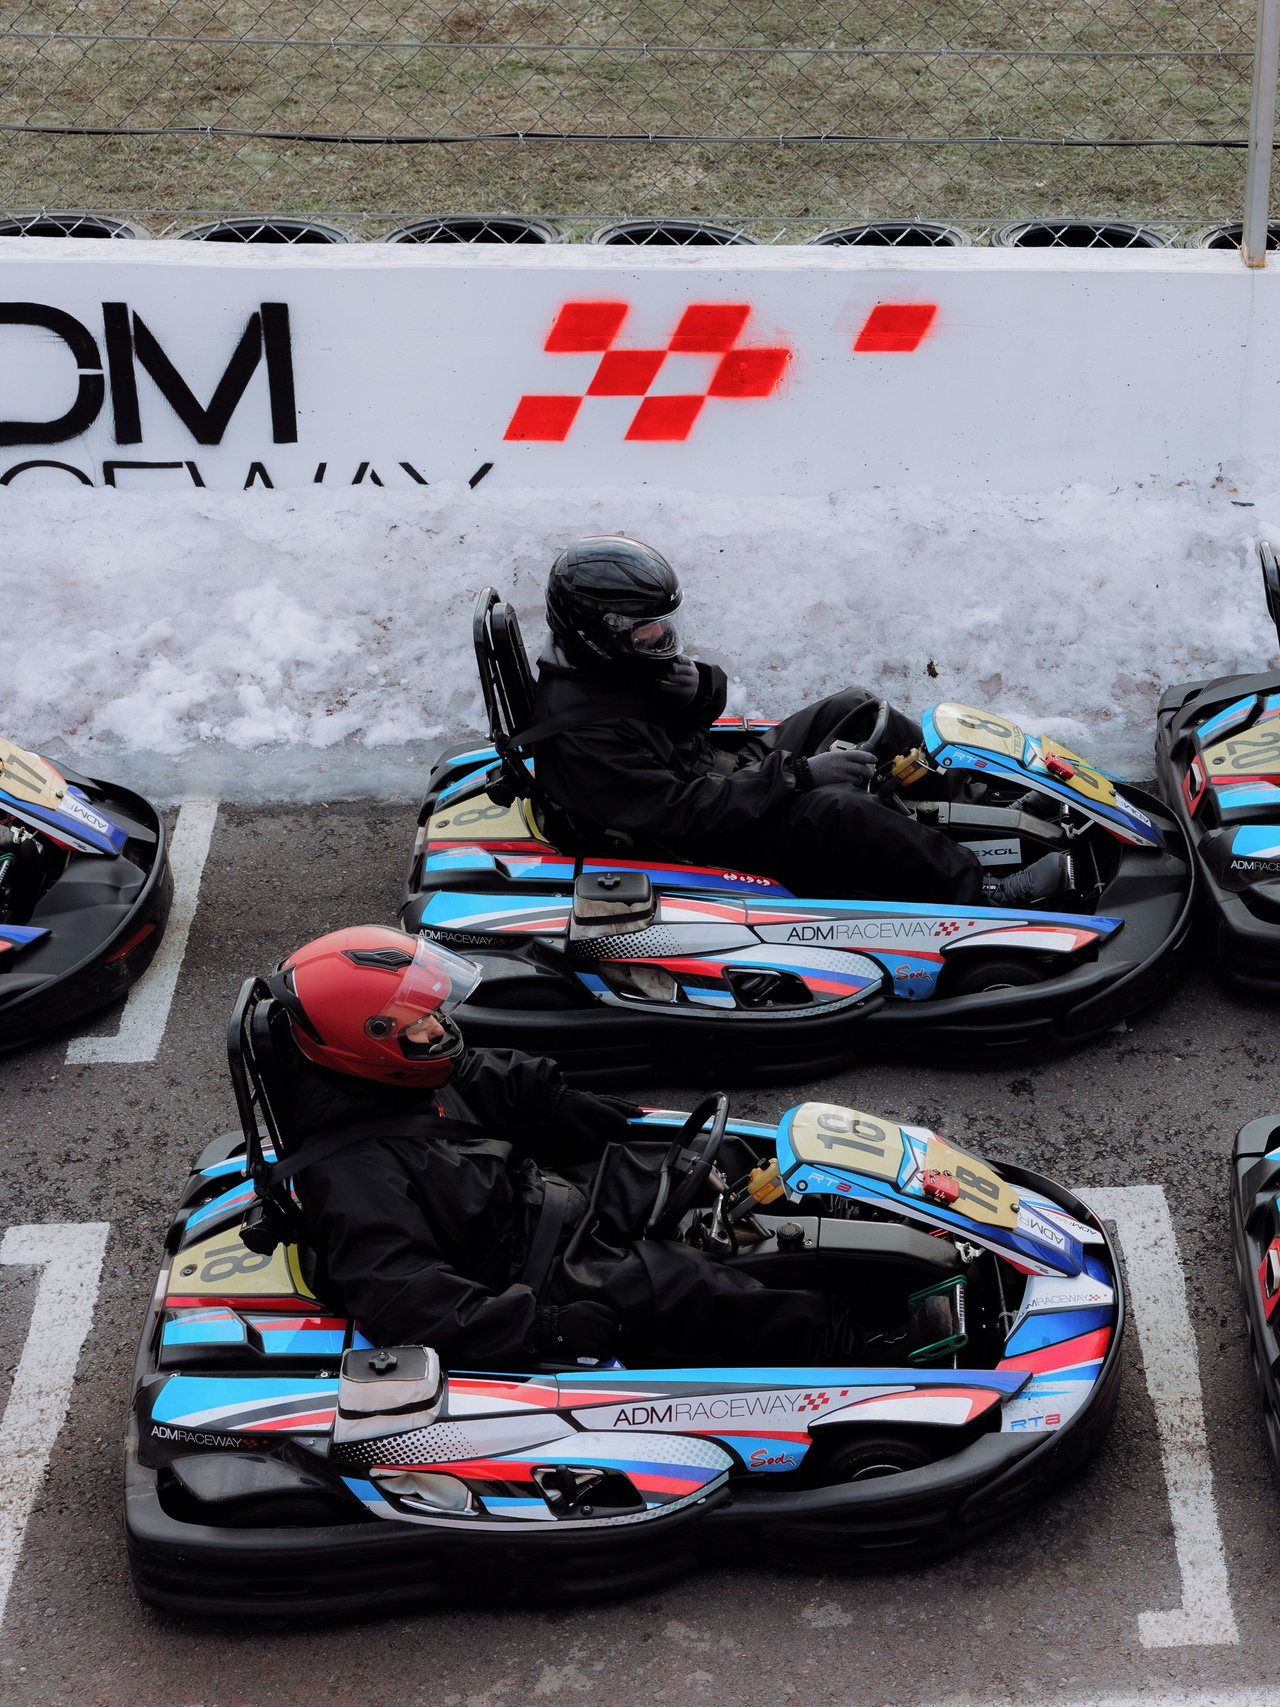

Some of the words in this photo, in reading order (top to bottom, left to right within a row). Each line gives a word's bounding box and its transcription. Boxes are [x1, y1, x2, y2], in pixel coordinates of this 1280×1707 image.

[956, 713, 1012, 739] 8
[951, 751, 988, 769] RT8
[418, 929, 494, 946] ADMRACEWAY
[786, 920, 937, 943] ADMRACEWAY
[816, 1113, 887, 1158] 18
[807, 1171, 852, 1192] RT8
[613, 1393, 802, 1428] ADMRACEWAY
[1010, 1413, 1061, 1431] RT8
[150, 1425, 243, 1449] ADMRACEWAY
